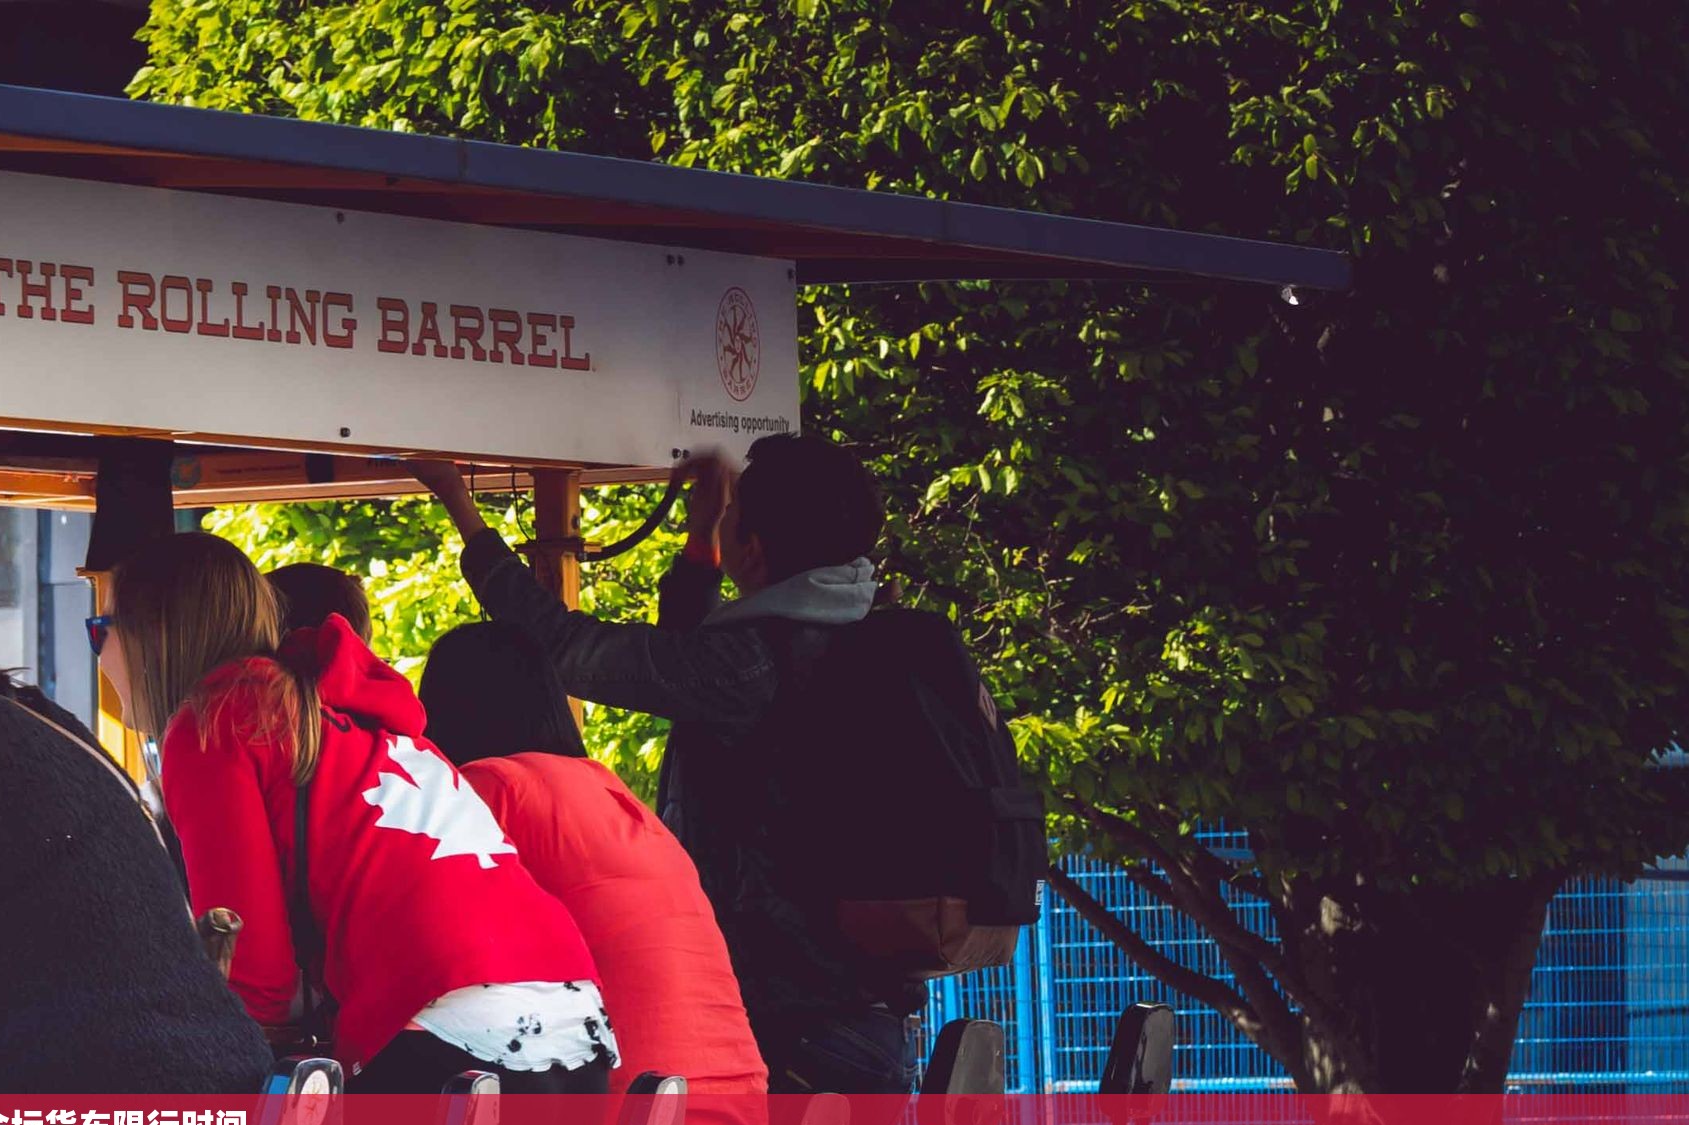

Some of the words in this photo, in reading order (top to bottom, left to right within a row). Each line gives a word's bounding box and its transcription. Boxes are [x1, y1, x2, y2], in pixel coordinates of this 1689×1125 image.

[117, 270, 358, 350] ROLLING
[377, 297, 591, 371] BARREL
[690, 409, 739, 433] Advertising
[741, 416, 790, 434] opportunity
